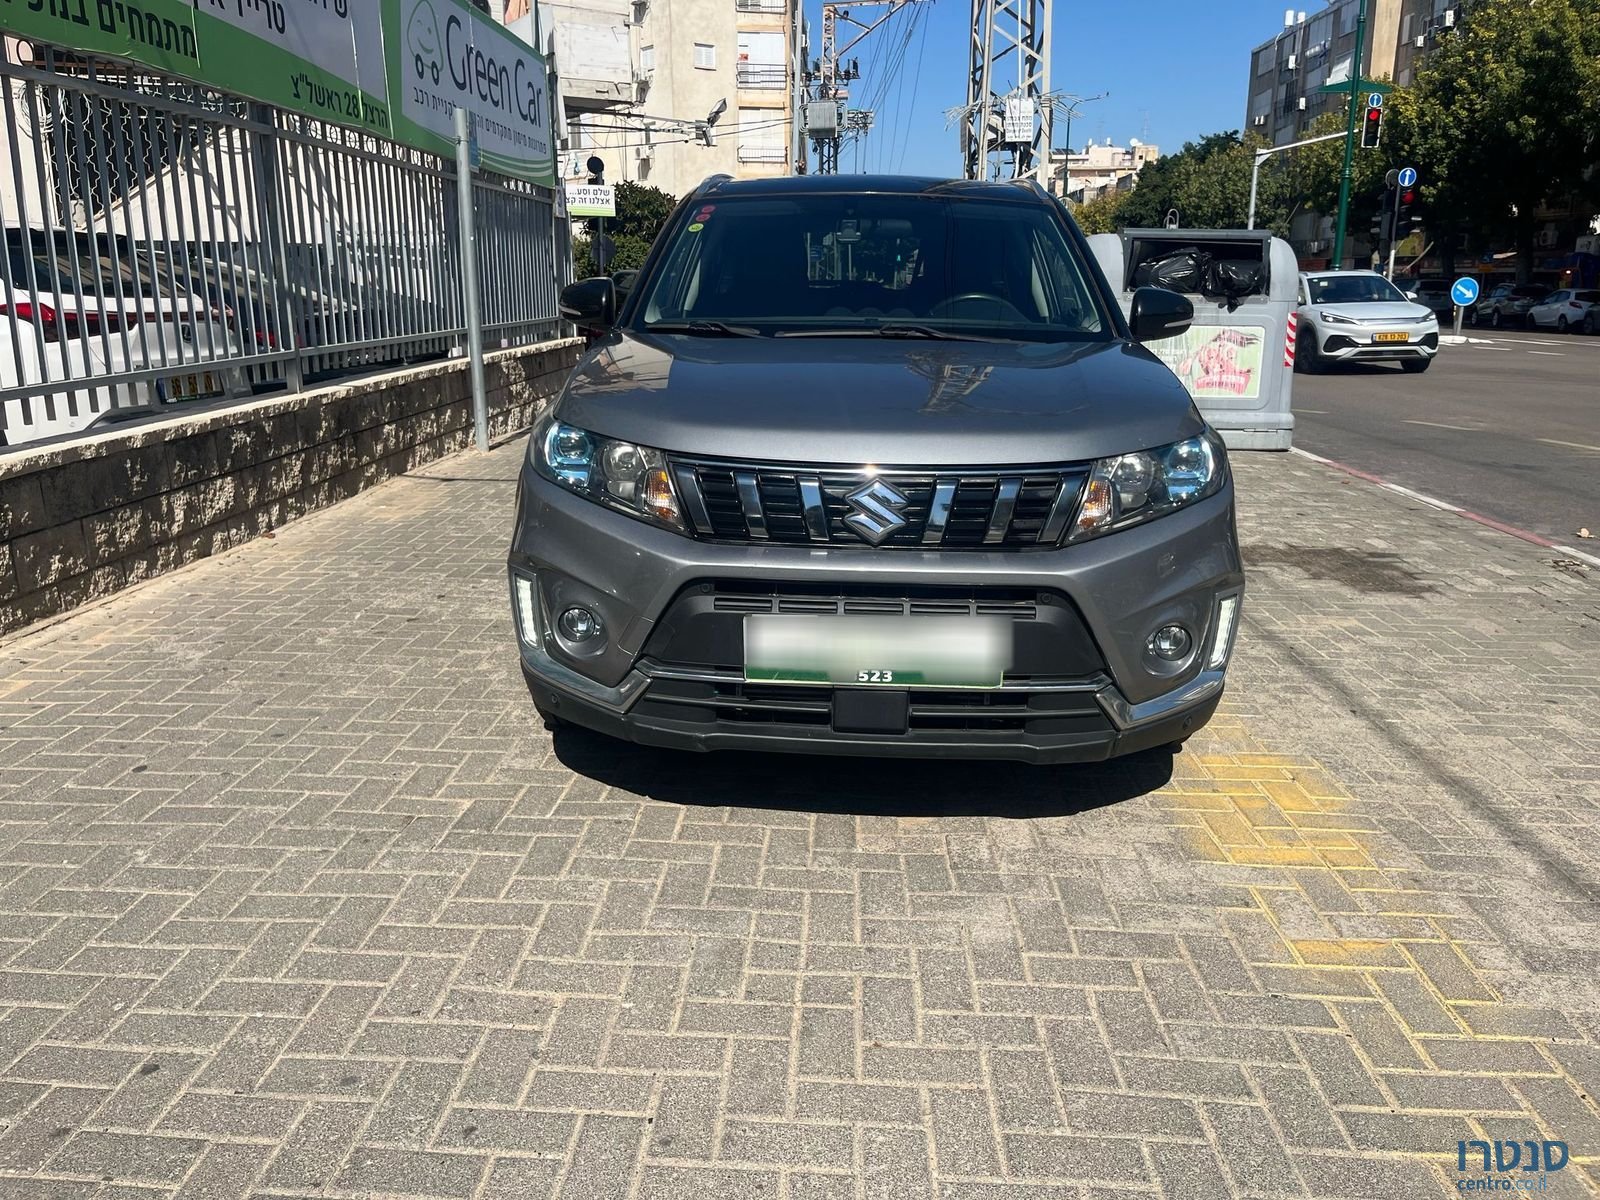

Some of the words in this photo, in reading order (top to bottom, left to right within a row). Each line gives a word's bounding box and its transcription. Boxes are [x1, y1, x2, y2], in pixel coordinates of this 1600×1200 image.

[97, 0, 197, 59] מתמחים
[446, 14, 512, 113] Green
[514, 59, 542, 128] Car
[344, 92, 360, 119] 28
[413, 86, 430, 108] רכב
[362, 96, 388, 129] הרצל
[566, 197, 576, 205] קצ
[589, 197, 610, 205] אצלנו
[593, 187, 610, 196] שלם
[858, 669, 893, 682] 523
